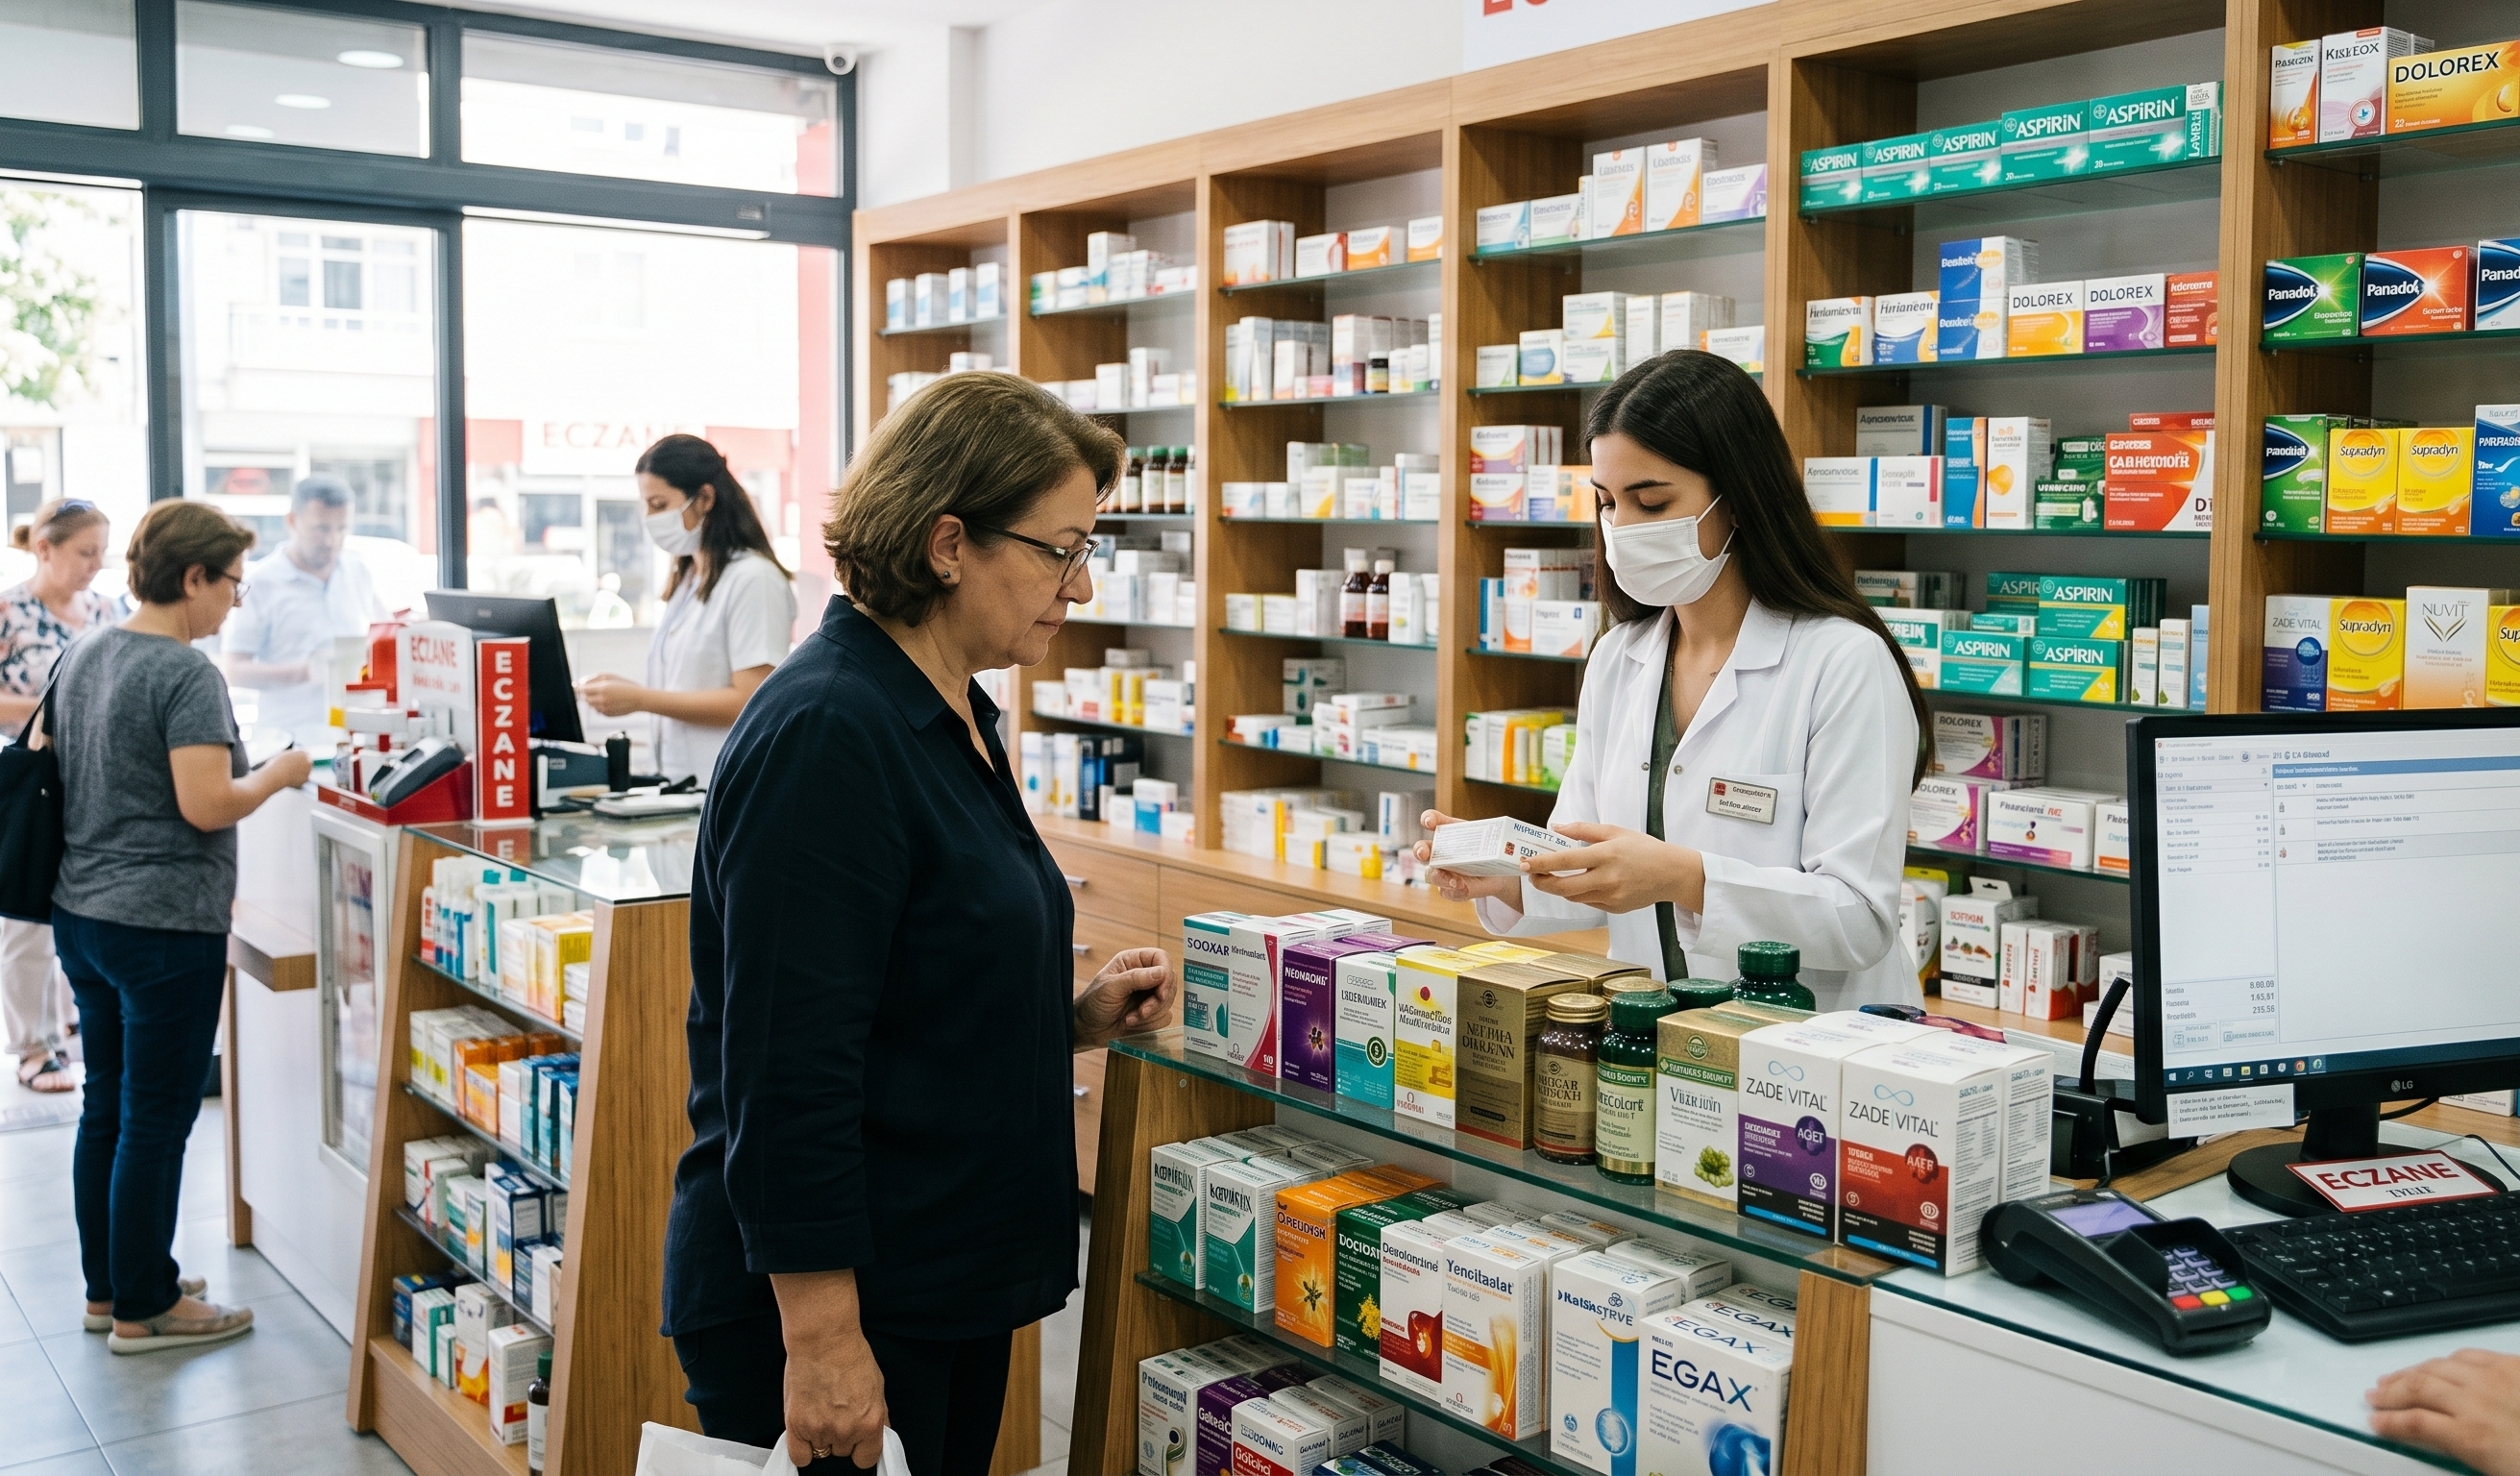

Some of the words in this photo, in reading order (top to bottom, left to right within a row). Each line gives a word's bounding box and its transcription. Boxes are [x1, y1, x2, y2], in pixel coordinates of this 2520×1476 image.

[2395, 52, 2500, 84] DOLOREX
[2013, 293, 2072, 308] DOLOREX
[2091, 285, 2153, 303] DOLOREX
[2411, 443, 2459, 456] Supradyn
[2000, 579, 2041, 595] ASPIR
[2422, 603, 2470, 617] NUVIT
[2272, 617, 2295, 627] ZADE
[2339, 619, 2391, 633] Supradyn
[493, 651, 515, 807] ECZANE
[1187, 937, 1230, 956] SOOXAR
[1747, 1077, 1783, 1101] ZADE
[1788, 1087, 1827, 1112] VITAL
[1849, 1100, 1890, 1126] ZADE
[1896, 1112, 1938, 1138] VITAL
[2315, 1163, 2460, 1191] ECZANE
[1747, 1292, 1797, 1311] EG
[1713, 1306, 1795, 1339] EGAX
[1672, 1319, 1767, 1354] EGAX
[1651, 1348, 1753, 1413] EGAX
